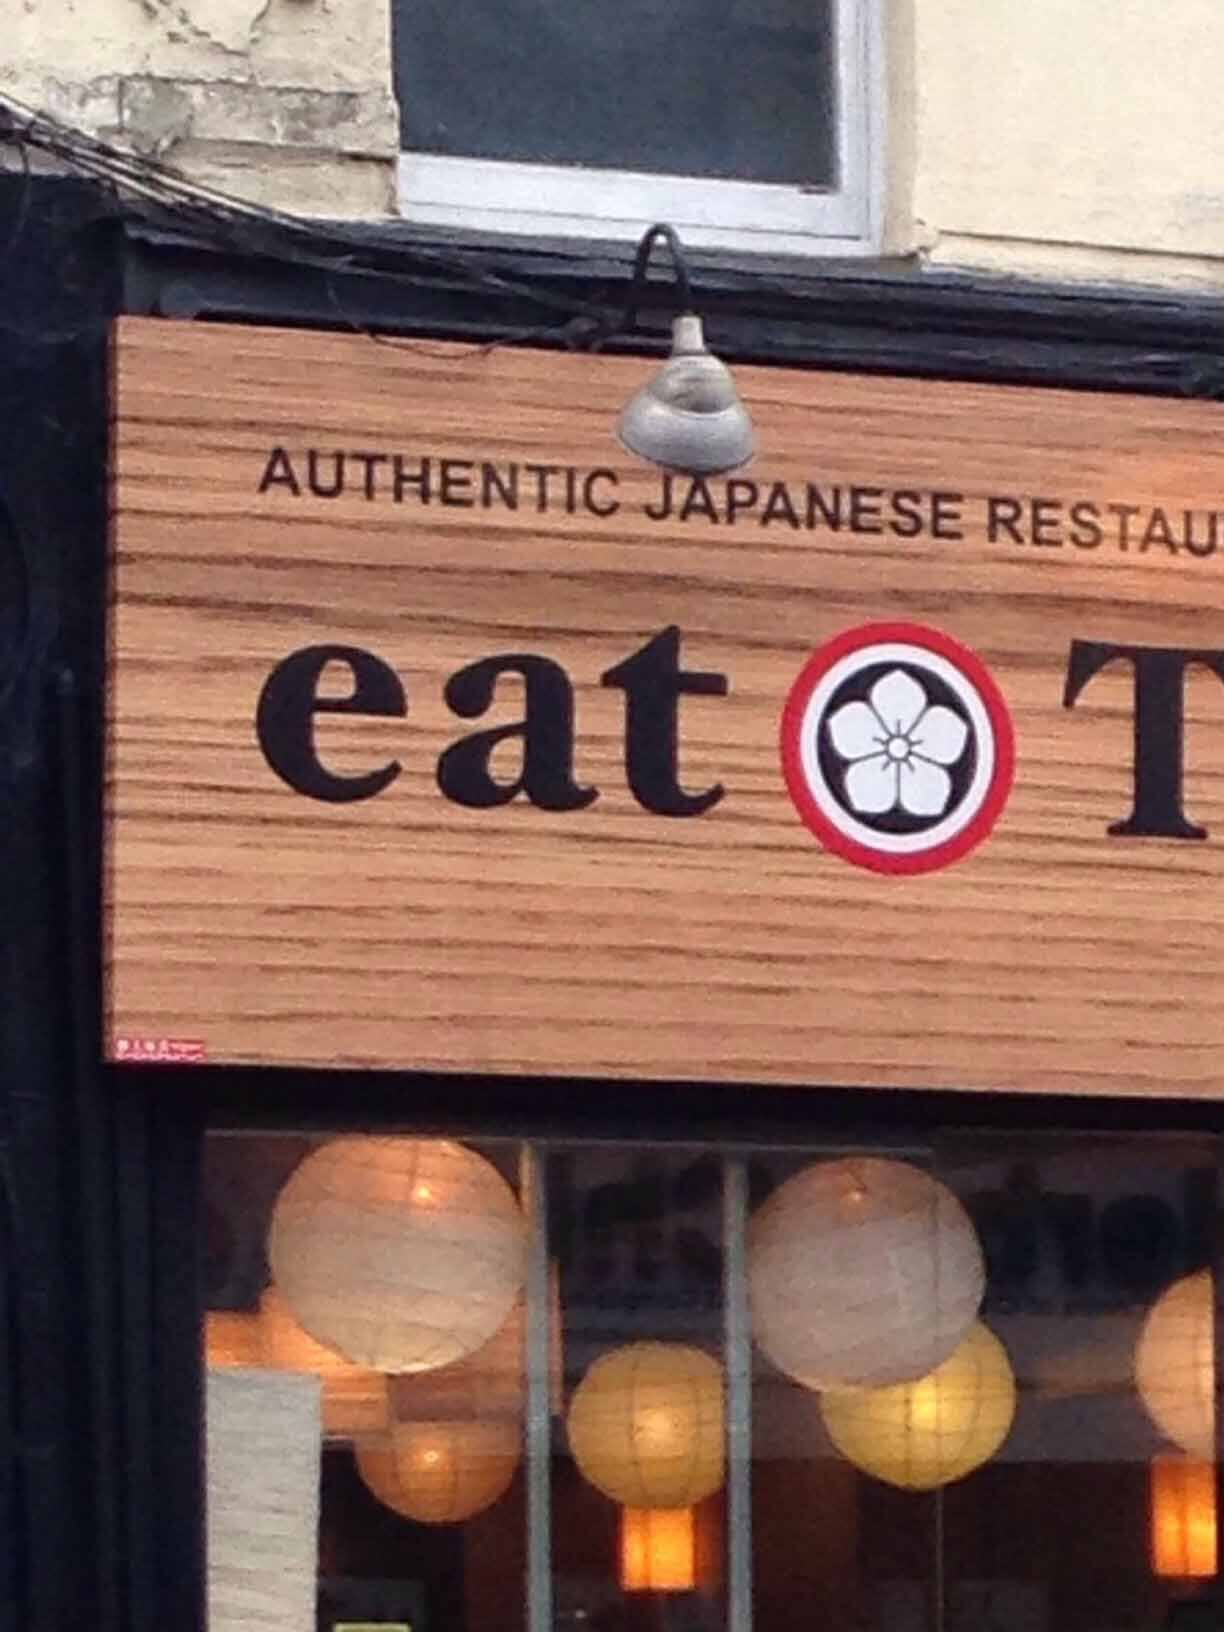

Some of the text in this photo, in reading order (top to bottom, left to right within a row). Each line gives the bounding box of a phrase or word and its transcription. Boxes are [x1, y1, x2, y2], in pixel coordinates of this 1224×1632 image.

[258, 445, 620, 518] AUTHENTIC
[643, 472, 965, 541] JAPANESE
[256, 624, 729, 818] eat
